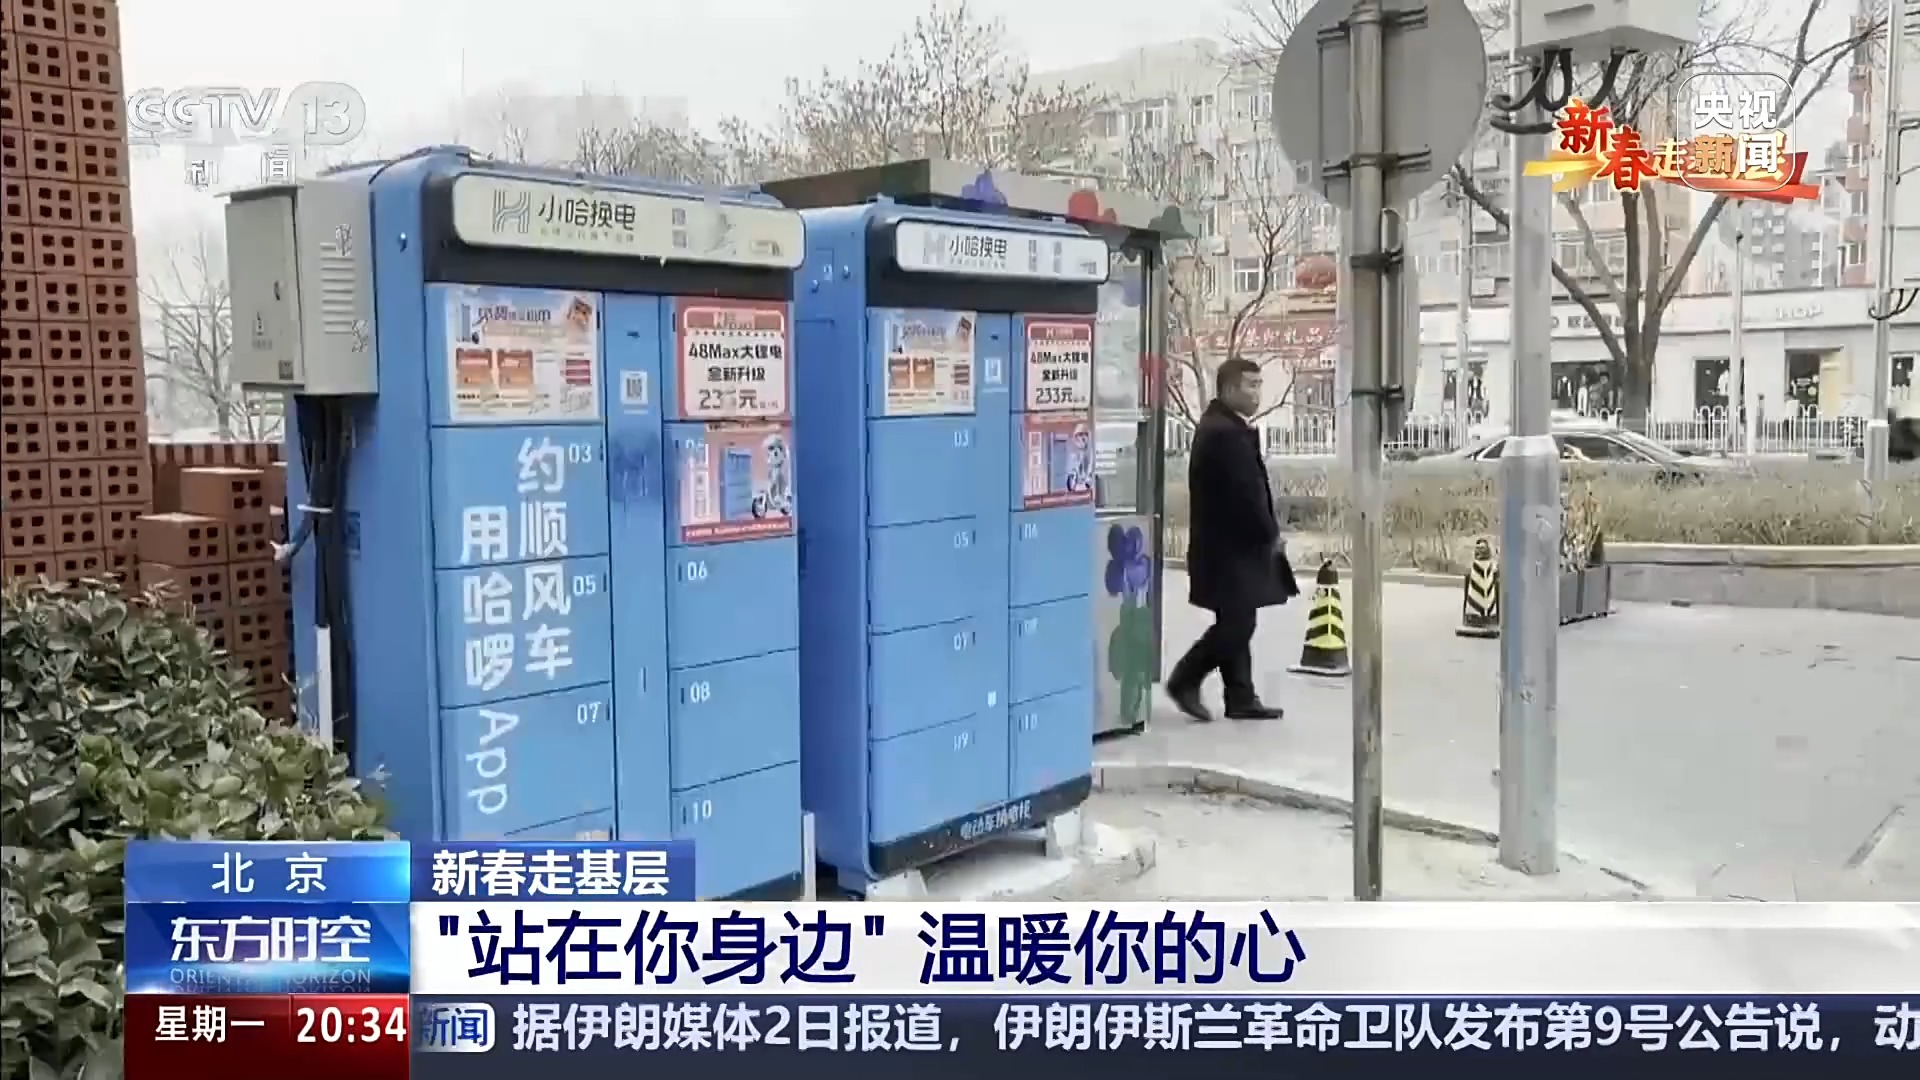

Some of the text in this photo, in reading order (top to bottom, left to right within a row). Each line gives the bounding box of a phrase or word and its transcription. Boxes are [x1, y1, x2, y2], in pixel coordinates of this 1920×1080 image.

[537, 195, 637, 231] 小哈换电
[950, 235, 1008, 259] 小哈换电
[1035, 387, 1073, 405] 233元
[953, 430, 970, 448] 03
[568, 443, 593, 464] 03
[953, 531, 969, 549] 05
[517, 437, 574, 680] 约顺风车
[687, 561, 708, 581] 06
[573, 575, 597, 596] 05
[690, 681, 711, 704] 08
[577, 702, 602, 724] 07
[692, 800, 713, 824] 10
